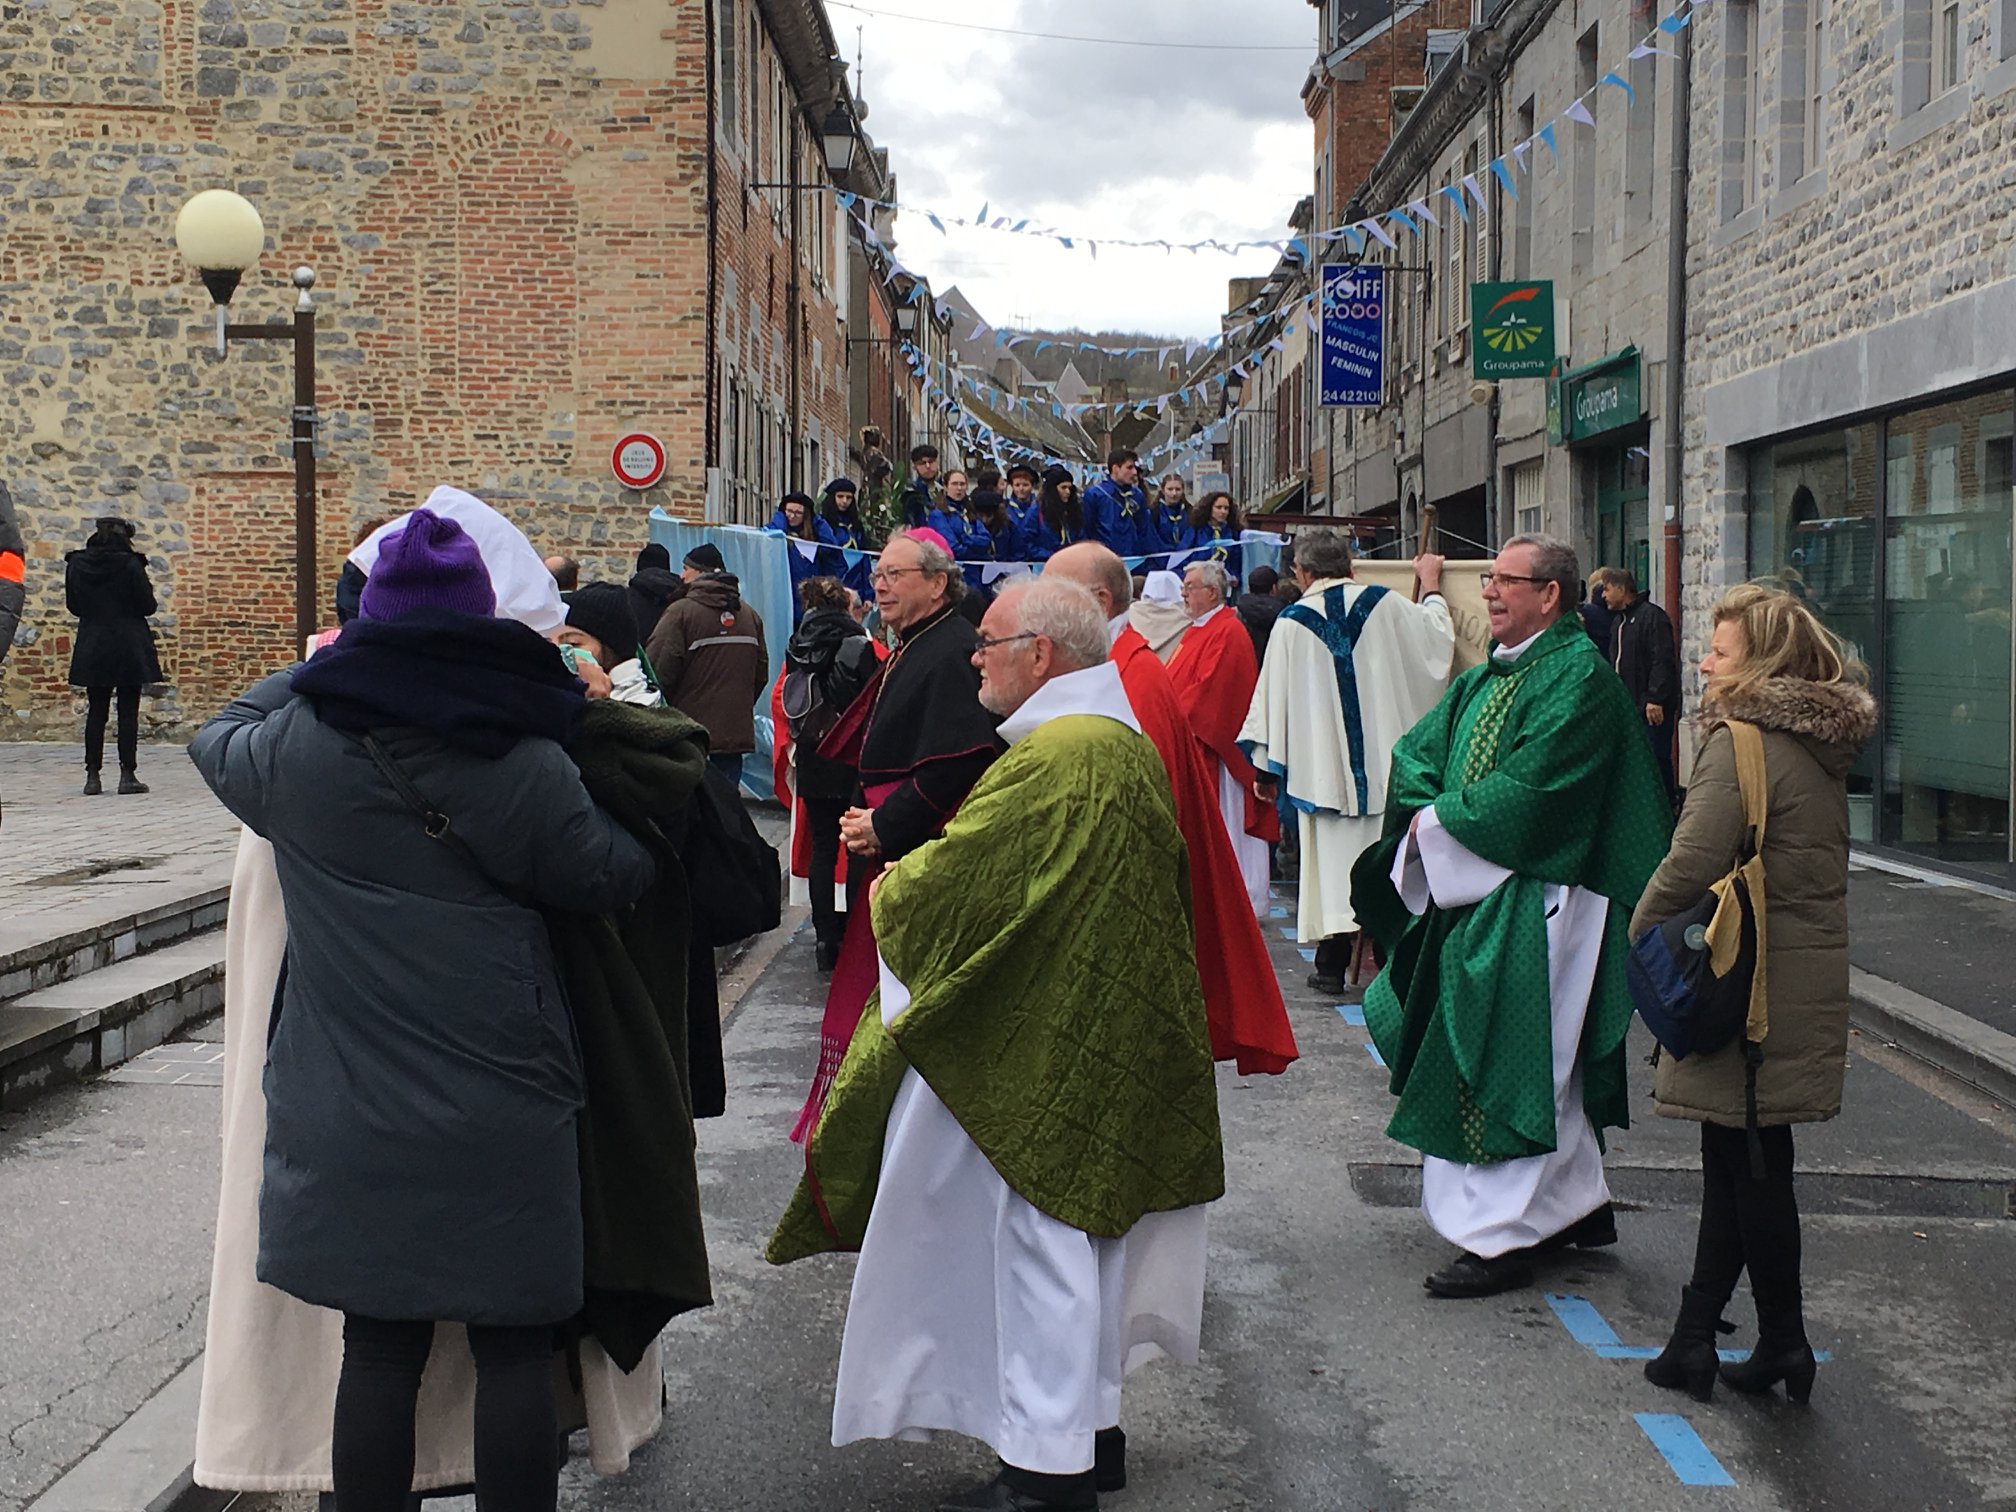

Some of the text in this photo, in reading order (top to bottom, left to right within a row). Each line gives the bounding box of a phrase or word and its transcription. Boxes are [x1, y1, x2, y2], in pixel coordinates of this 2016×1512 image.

[1324, 303, 1380, 320] 2000
[1326, 336, 1379, 362] MASCULIN
[1331, 356, 1373, 378] FEMININ
[1483, 359, 1545, 371] Groupama
[1576, 386, 1618, 422] Groupama
